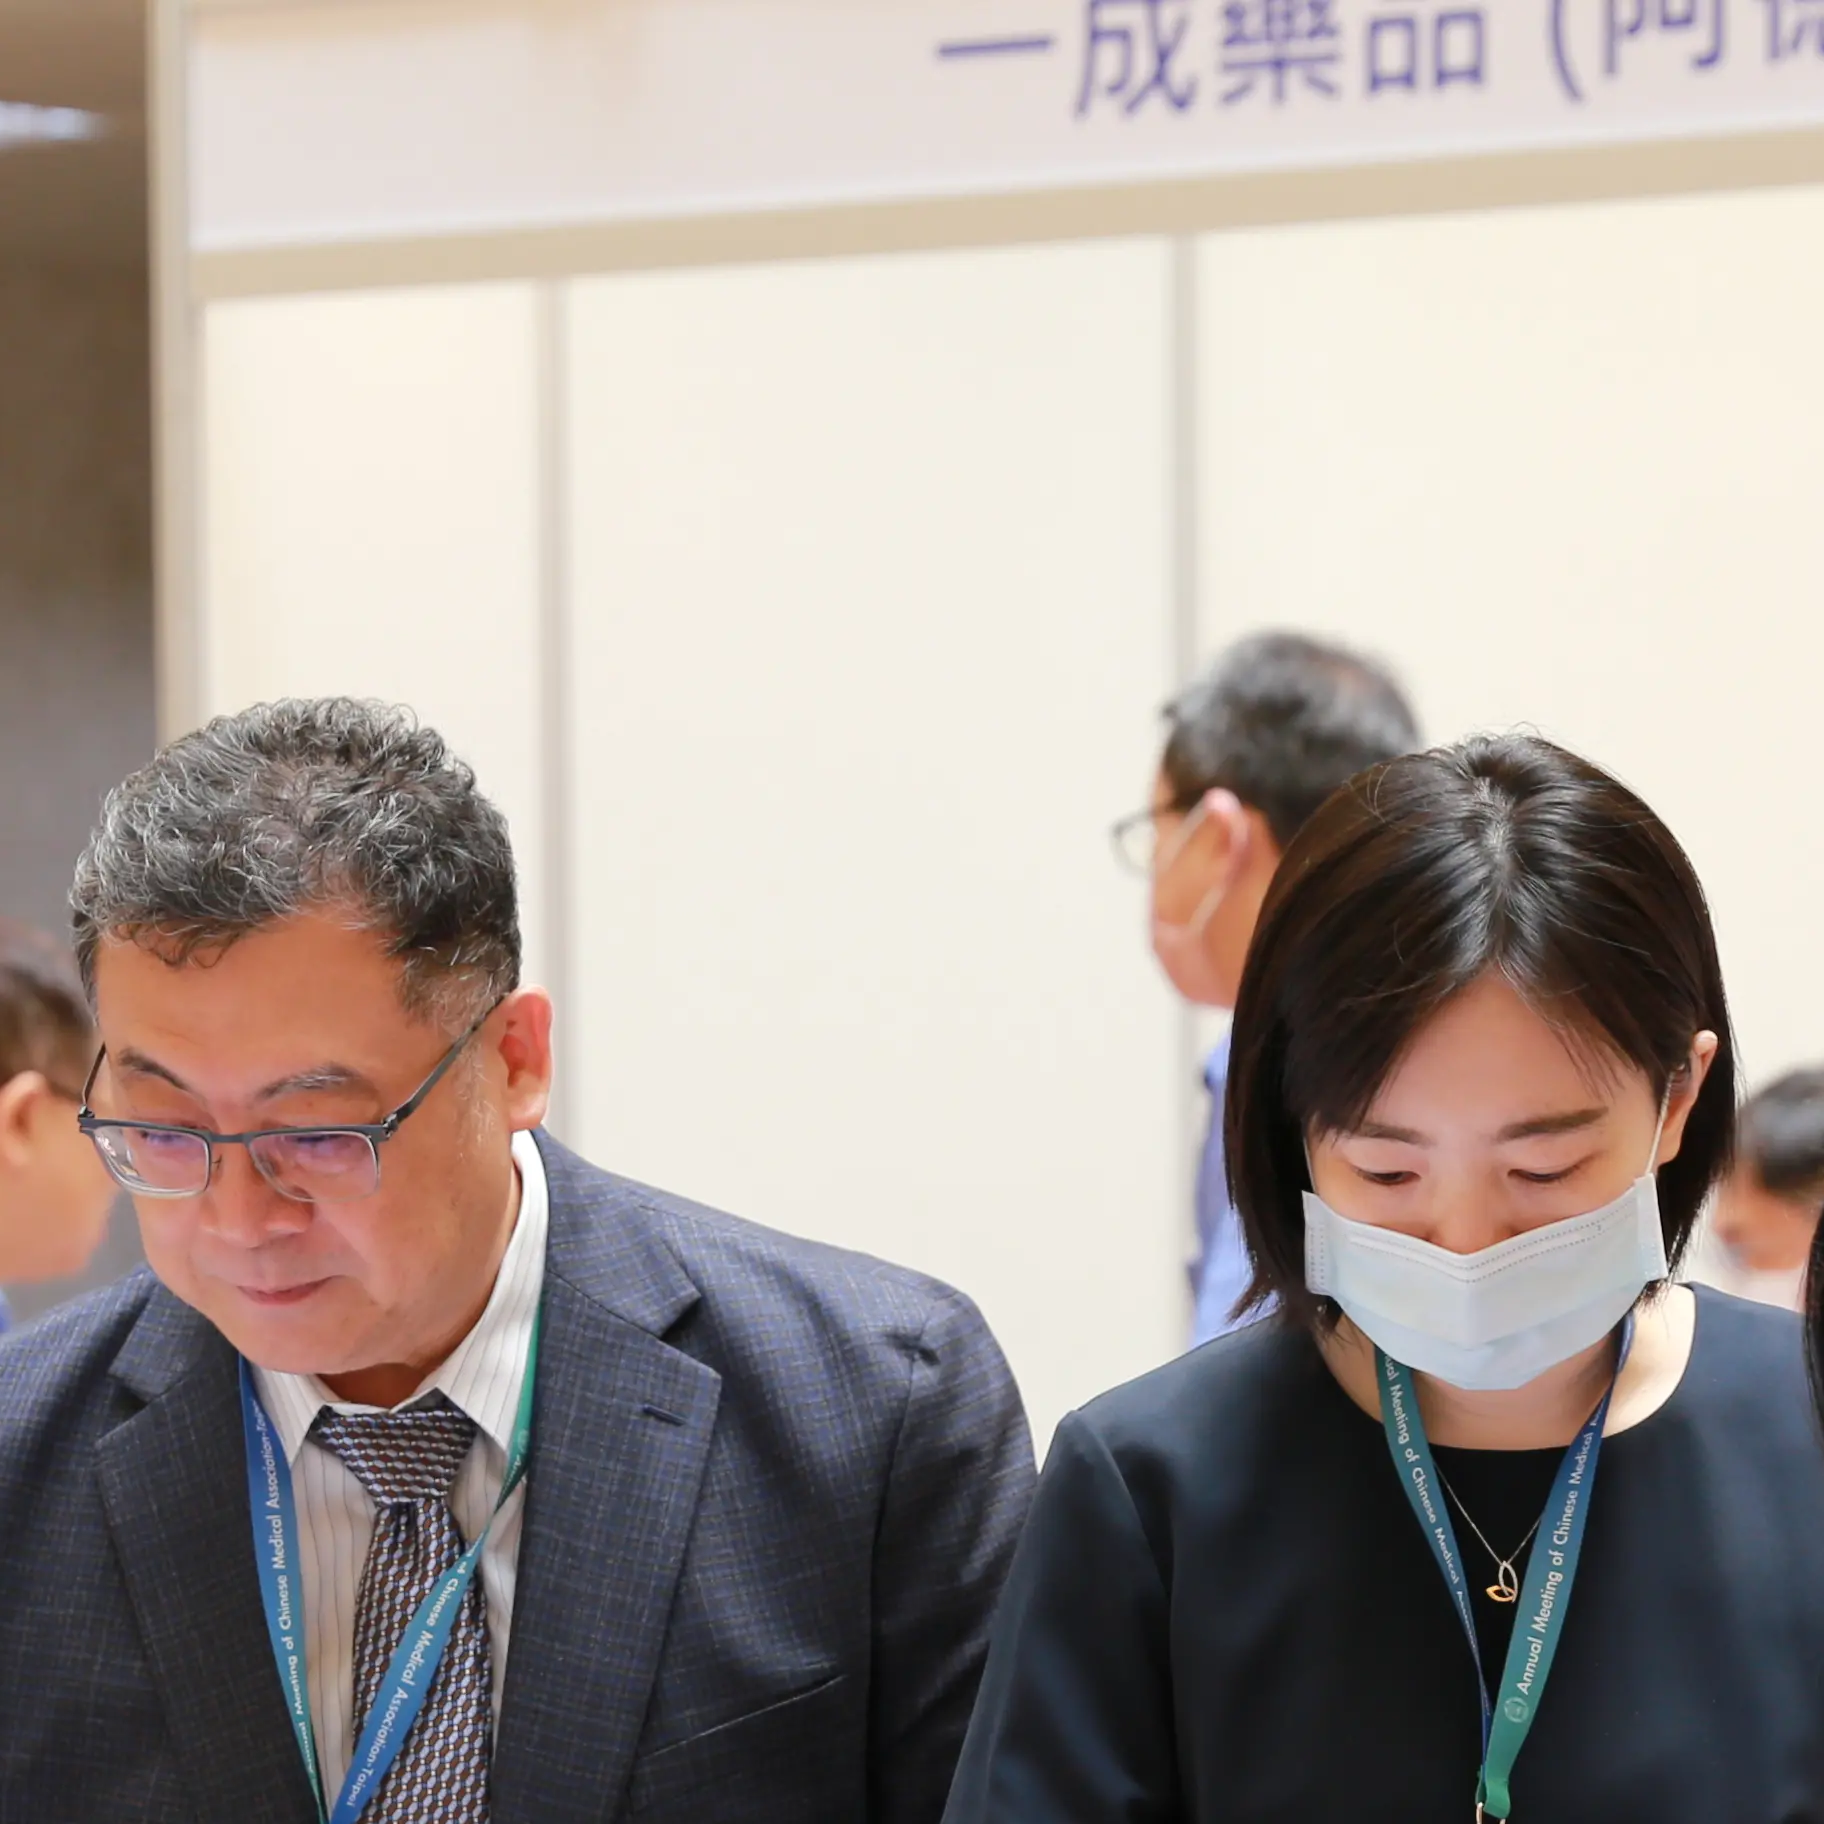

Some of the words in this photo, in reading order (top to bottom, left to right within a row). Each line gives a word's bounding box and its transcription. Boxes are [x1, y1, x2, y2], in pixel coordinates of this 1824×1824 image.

[1390, 1384, 1410, 1445] Meeting
[1404, 1448, 1421, 1463] of
[1568, 1432, 1594, 1485] Medical
[1412, 1467, 1436, 1524] Chinese
[1553, 1490, 1578, 1545] Chinese
[266, 1514, 286, 1569] Medical
[1434, 1527, 1460, 1584] Medical
[1548, 1549, 1565, 1566] of
[277, 1575, 292, 1630] Chinese
[427, 1578, 458, 1627] Chinese
[1531, 1570, 1564, 1634] Meeting
[281, 1636, 294, 1650] of
[401, 1630, 434, 1686] Medical
[1516, 1636, 1544, 1695] Annual
[346, 1686, 409, 1807] Association-Taipei
